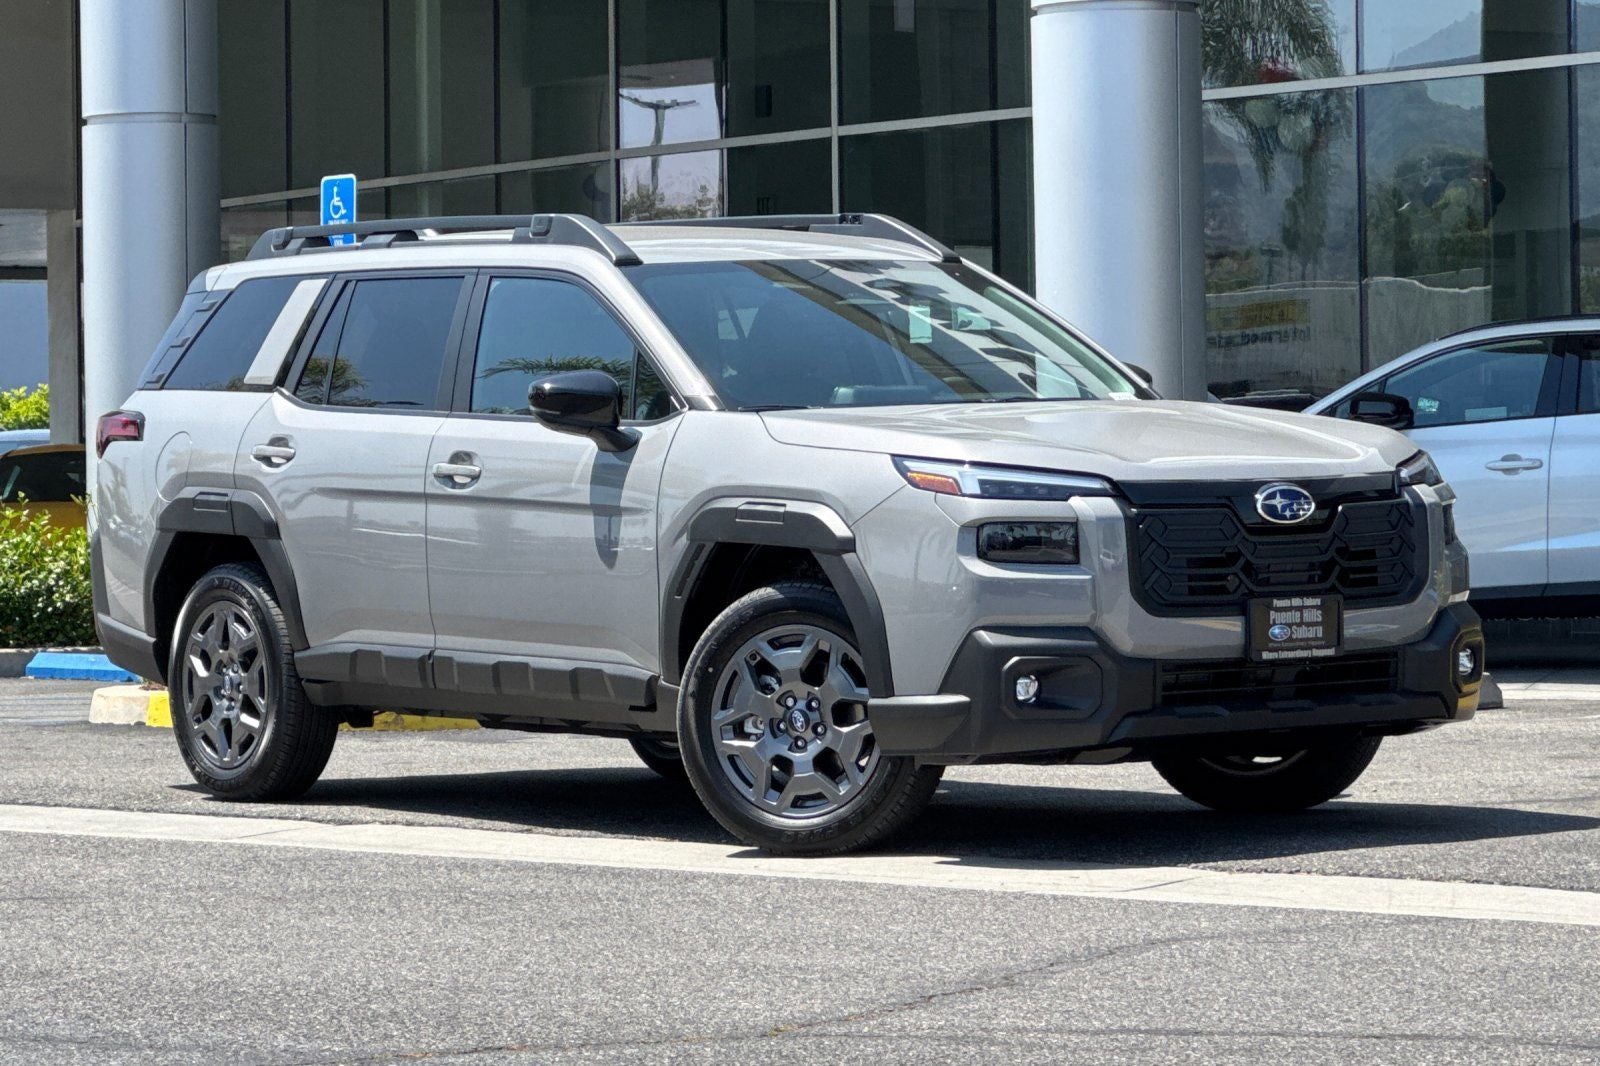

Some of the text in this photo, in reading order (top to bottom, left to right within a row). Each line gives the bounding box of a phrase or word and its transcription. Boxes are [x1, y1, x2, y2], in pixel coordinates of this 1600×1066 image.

[1303, 596, 1321, 606] Subaru
[1269, 608, 1322, 624] Puente Hills
[1292, 625, 1323, 639] Subaru
